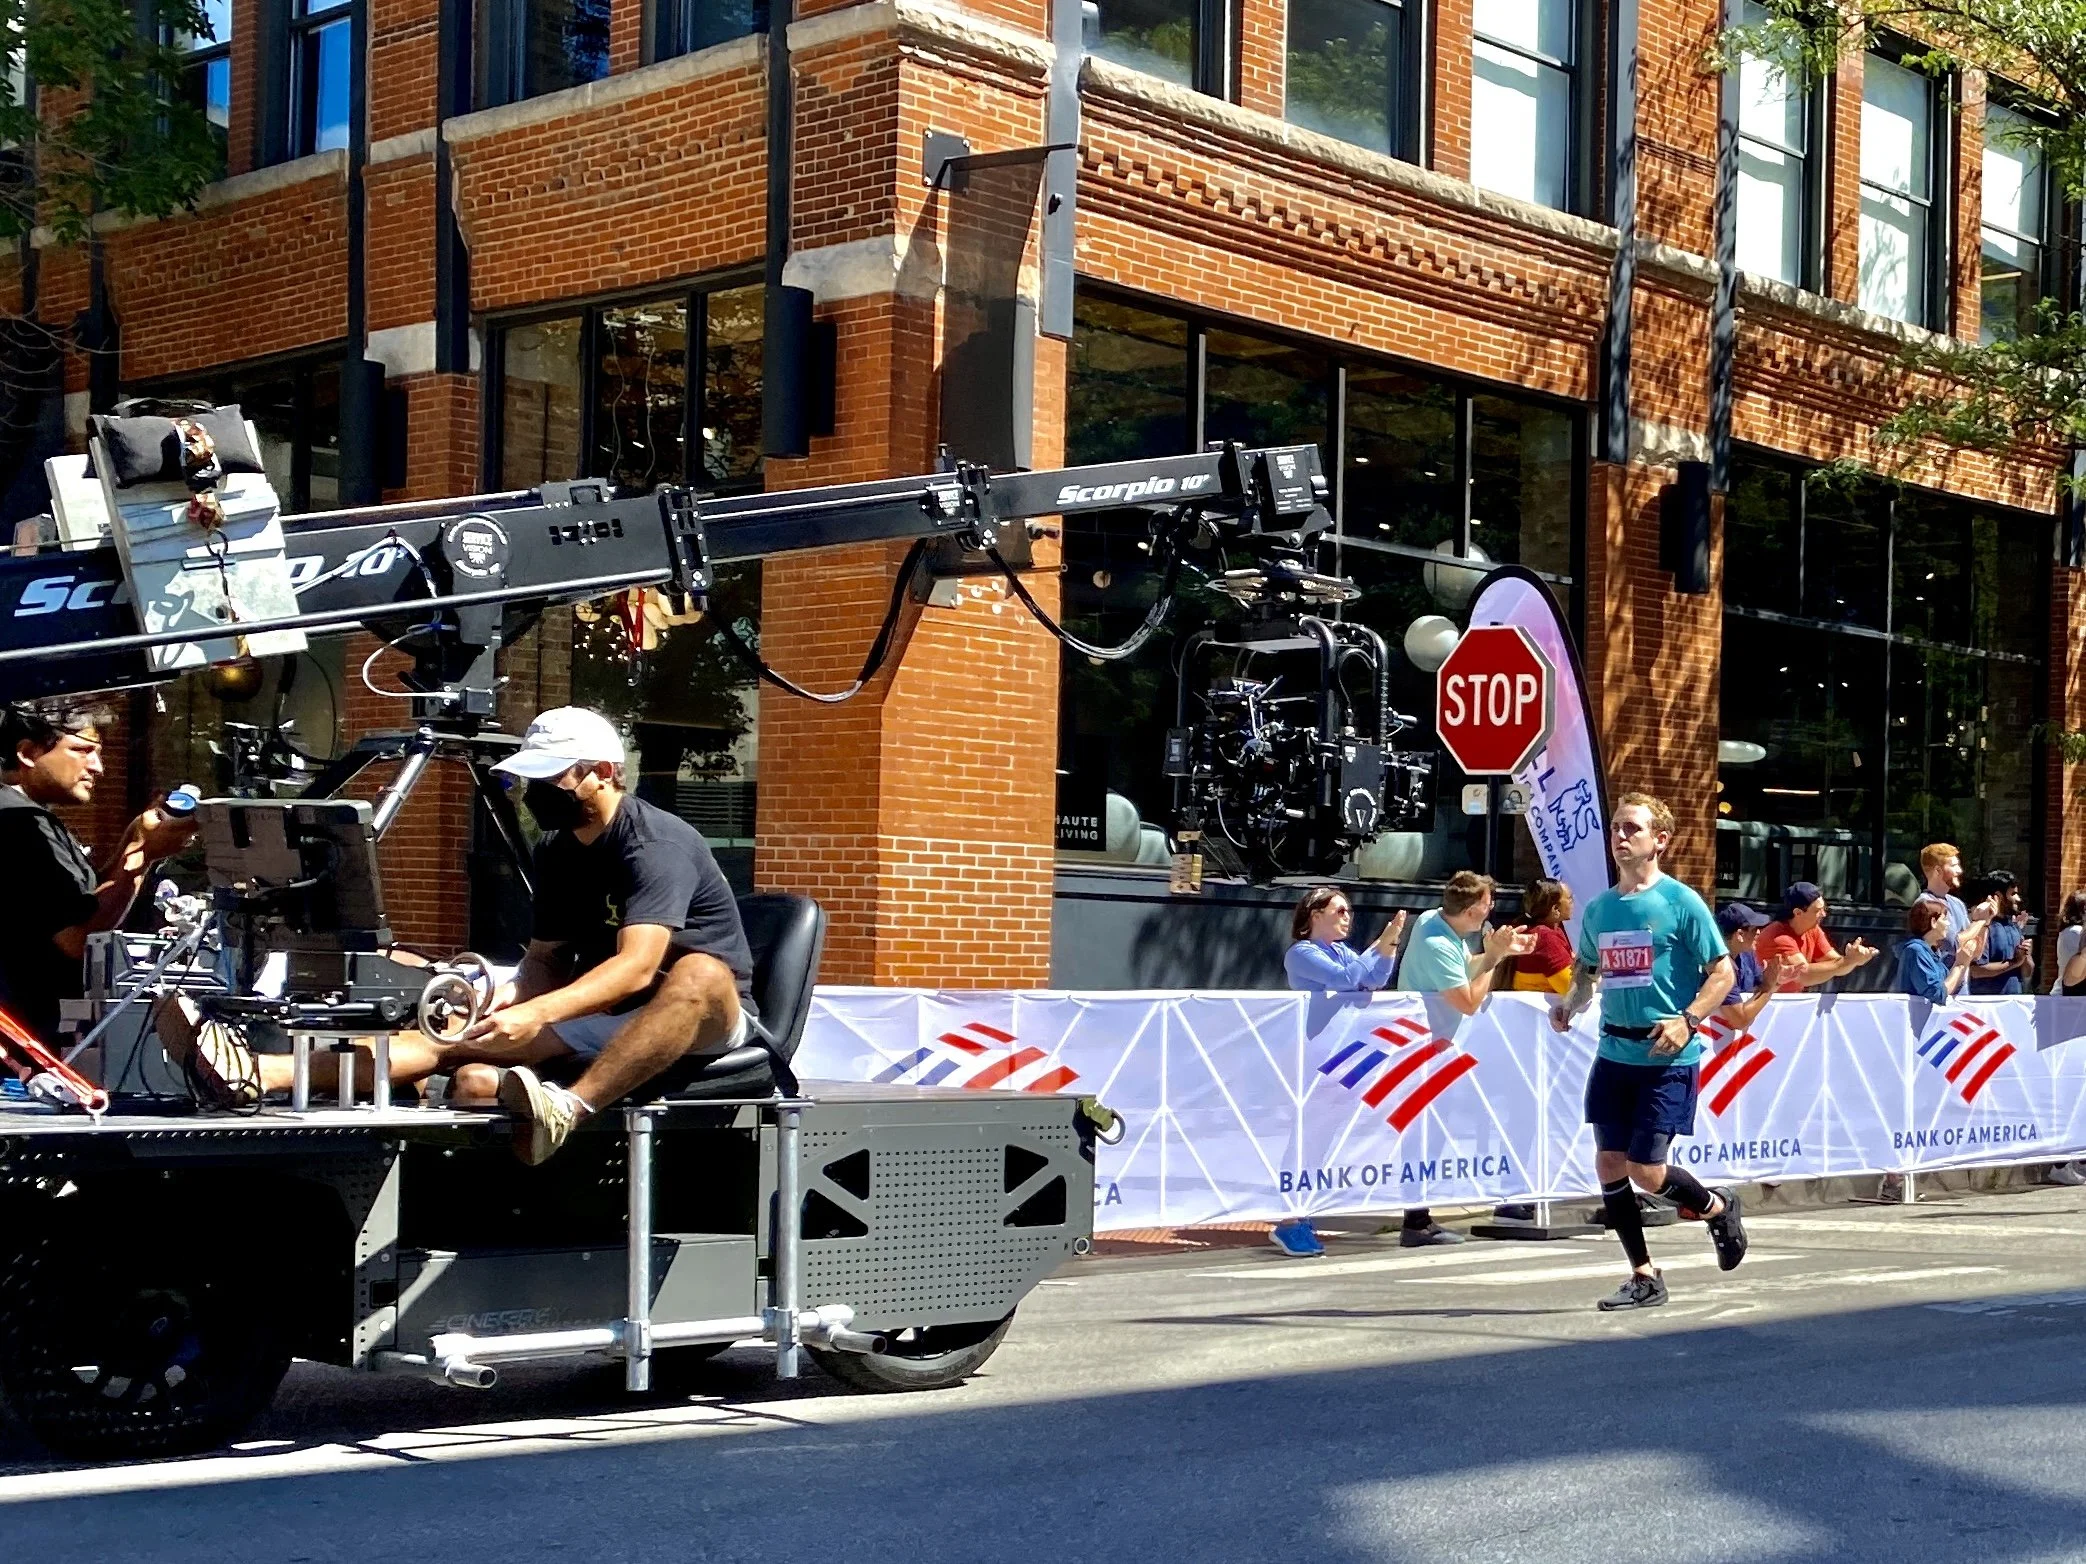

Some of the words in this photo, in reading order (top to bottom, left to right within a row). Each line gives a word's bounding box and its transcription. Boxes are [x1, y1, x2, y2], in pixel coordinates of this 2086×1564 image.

[1056, 475, 1176, 505] Scorpio
[1445, 673, 1537, 727] STOP
[1055, 828, 1099, 841] IVING
[1531, 805, 1564, 879] COMPAN
[1688, 1144, 1713, 1164] OF
[1717, 1138, 1802, 1162] AMERICA
[1894, 1129, 1939, 1149] BANK
[1944, 1127, 1964, 1146] OF
[1968, 1123, 2038, 1144] AMERICA
[1280, 1166, 1353, 1193] BANK
[1361, 1163, 1393, 1187] OF
[1400, 1155, 1511, 1184] AMERICA
